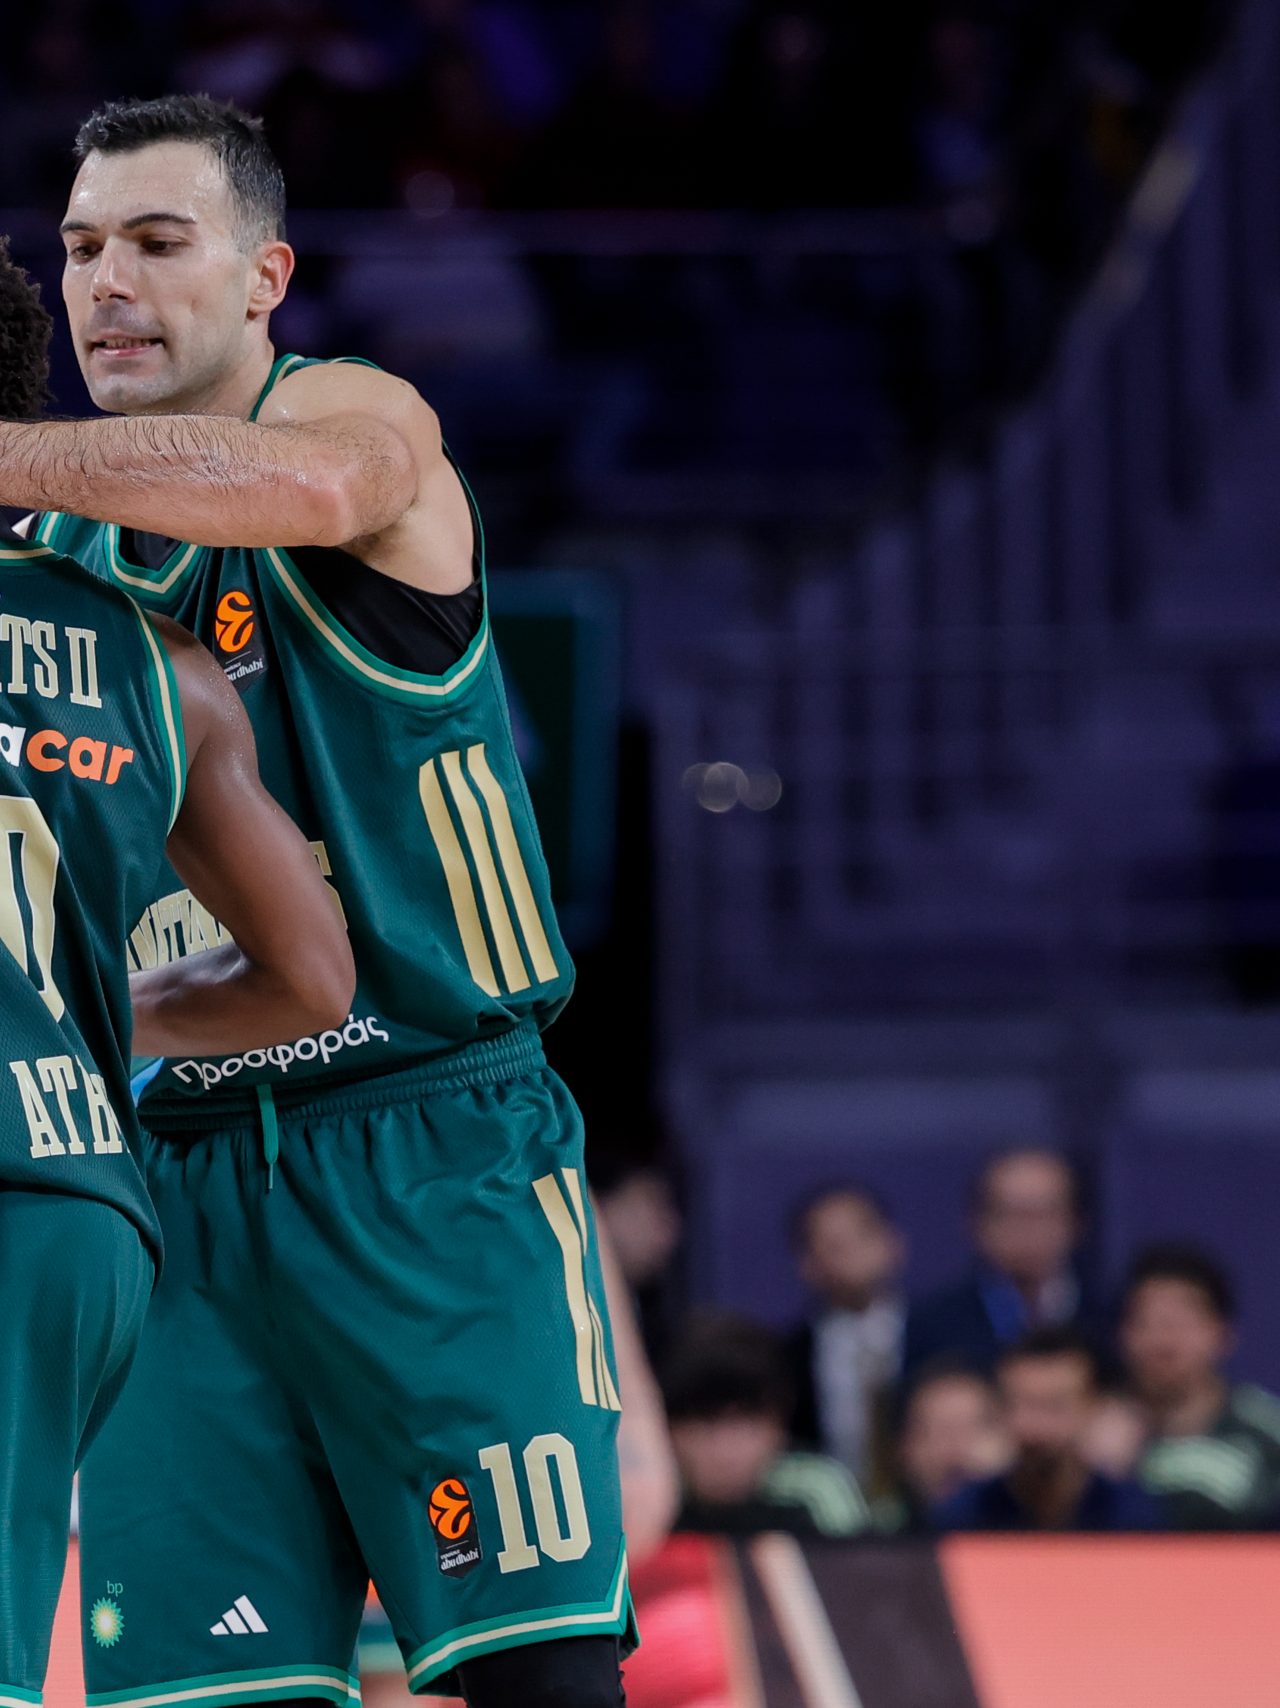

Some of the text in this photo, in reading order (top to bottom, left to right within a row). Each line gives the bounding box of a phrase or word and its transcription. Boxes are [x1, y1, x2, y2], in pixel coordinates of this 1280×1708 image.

[65, 626, 102, 708] II
[171, 1013, 389, 1090] Προσφοράς
[478, 1432, 592, 1574] 10
[106, 1580, 124, 1597] bp
